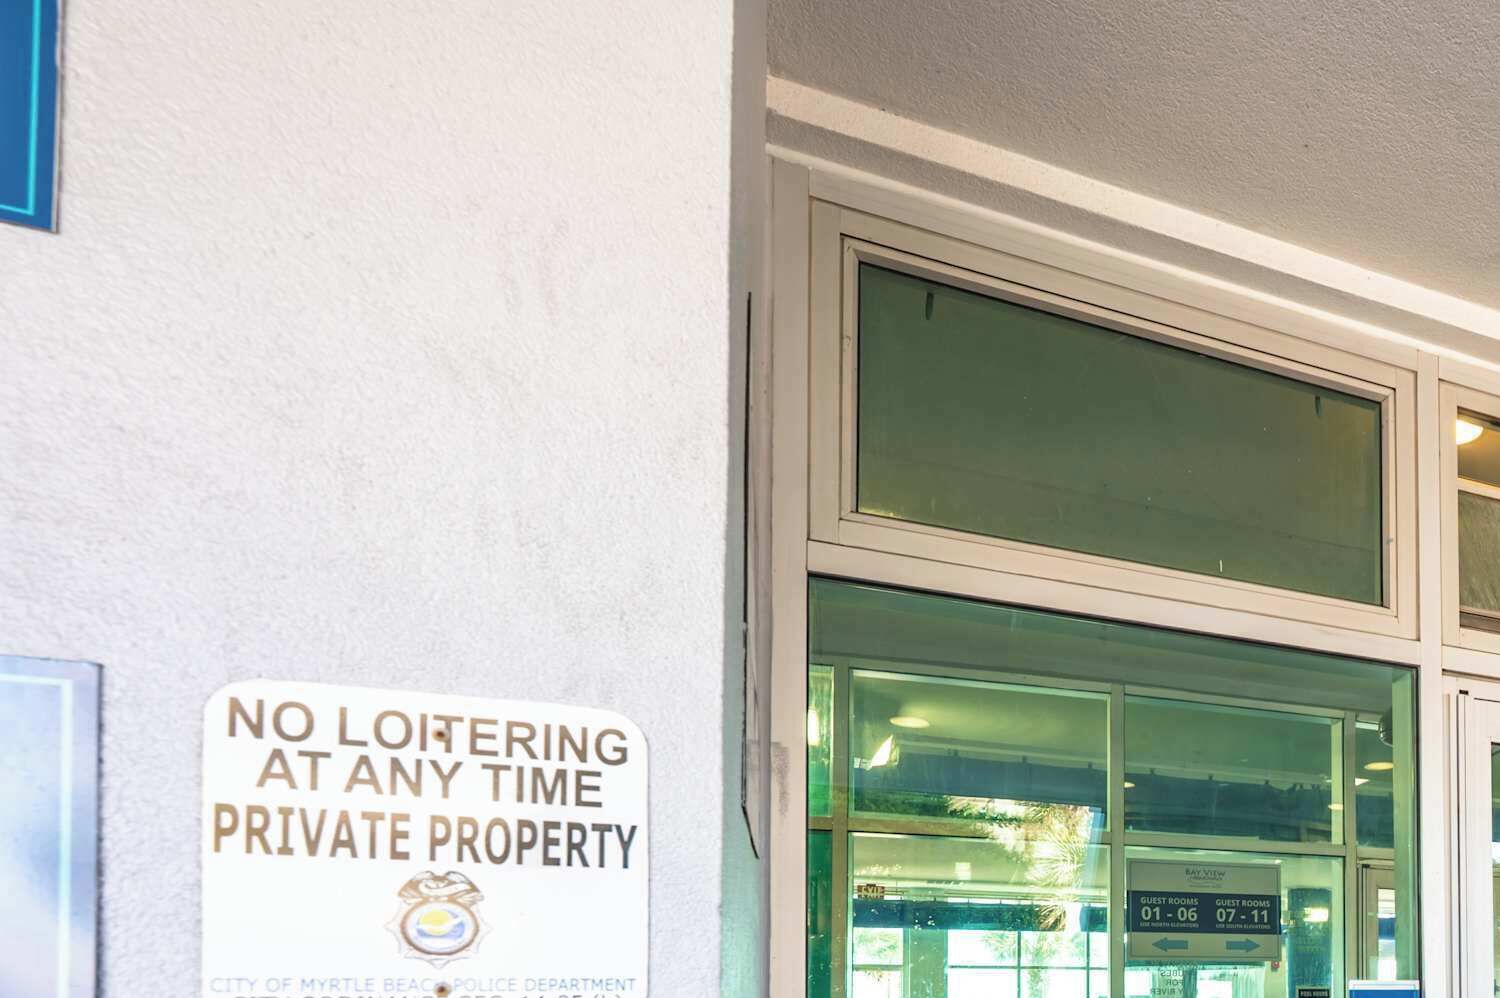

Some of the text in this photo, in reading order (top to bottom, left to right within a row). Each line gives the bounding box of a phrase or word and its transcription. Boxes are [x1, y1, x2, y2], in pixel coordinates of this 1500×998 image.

[227, 697, 629, 766] NO LOITERING
[256, 748, 603, 808] AT ANY TIME
[213, 803, 638, 869] PRIVATE PROPERTY
[1140, 897, 1166, 905] GUEST
[1216, 899, 1270, 908] GUEST ROOMS
[1141, 906, 1161, 920] 01
[1177, 907, 1198, 921] 06
[1216, 909, 1236, 922] 07
[1251, 910, 1268, 923] 11
[210, 977, 637, 993] CITY OF MYRTLE BEAC POLICE DEPARTMENT
